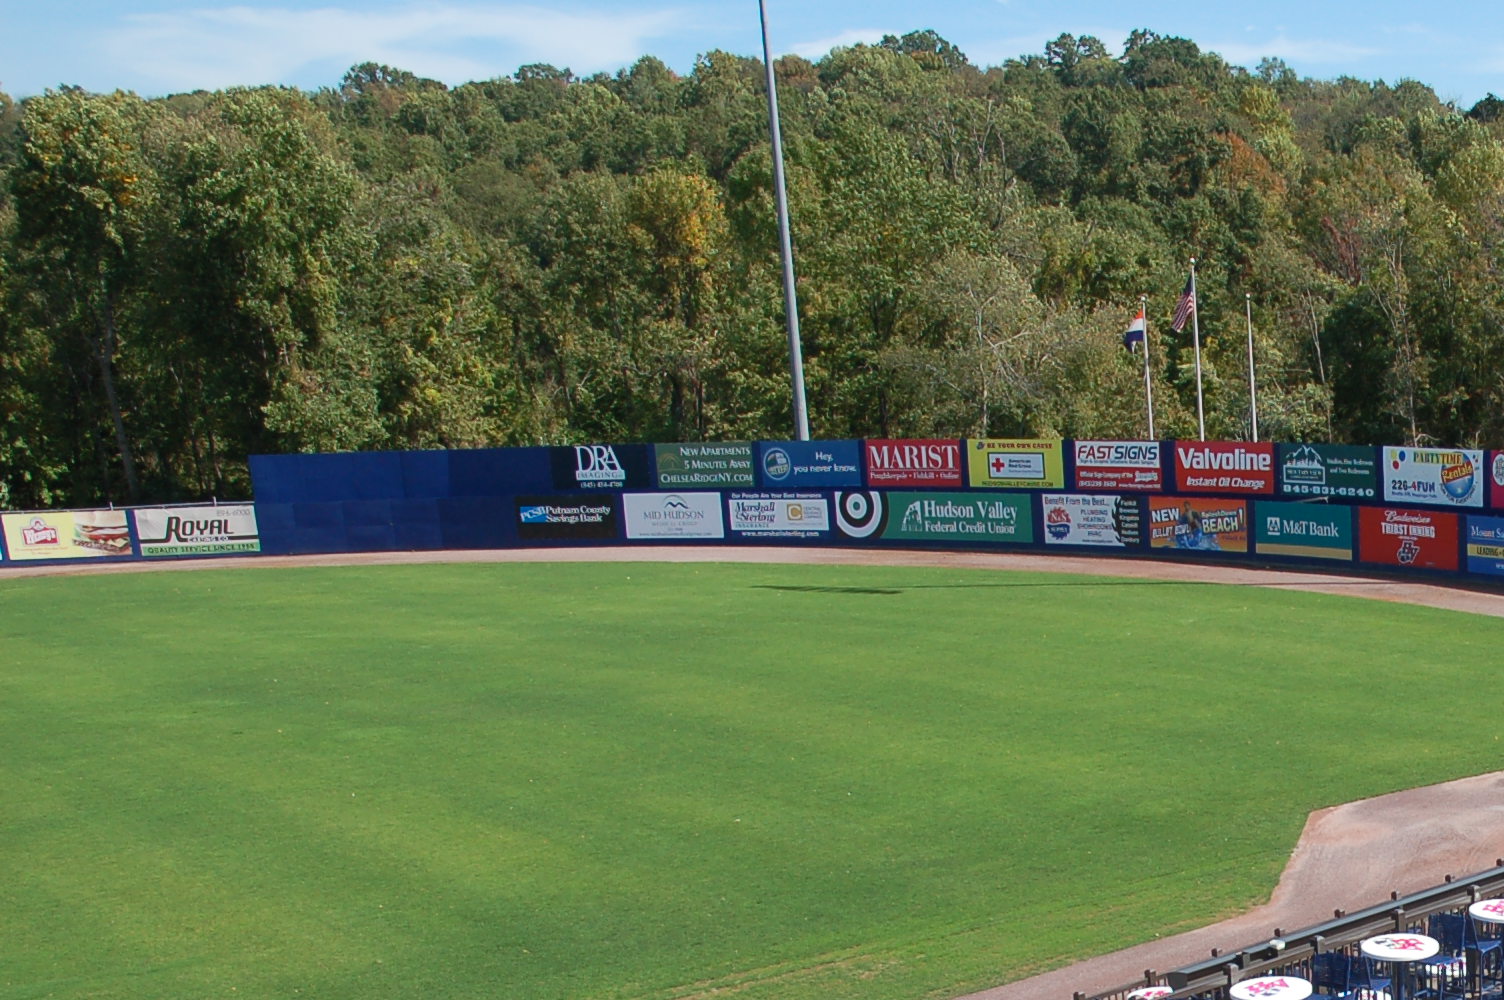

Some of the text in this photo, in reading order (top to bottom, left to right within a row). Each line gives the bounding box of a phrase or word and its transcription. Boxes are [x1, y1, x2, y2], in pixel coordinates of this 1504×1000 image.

[680, 446, 751, 456] NEW APARTMENTS
[869, 445, 959, 468] MARIST
[1077, 445, 1158, 460] FASTSIGNS
[574, 445, 622, 472] DRA
[684, 460, 751, 469] 5 MINUTES AWAY
[1178, 447, 1271, 471] Valvoline
[793, 464, 810, 475] you
[810, 465, 833, 473] never
[1186, 476, 1217, 487] Instant
[1218, 477, 1231, 487] Oil
[735, 502, 776, 512] Marshall
[1044, 497, 1090, 505] Benefit From the
[545, 505, 611, 516] Putnam County
[643, 510, 705, 520] MID HUDSON
[924, 499, 1018, 525] Hudson Valley
[1151, 508, 1179, 523] NEW
[545, 513, 603, 524] Savings Bank
[163, 516, 235, 543] ROYAL
[925, 520, 1015, 535] Federal Credit Union
[1202, 516, 1239, 534] BEACH
[1283, 523, 1339, 538] M&T Bank
[1470, 525, 1495, 537] Mount
[181, 545, 212, 553] SERVICE
[213, 544, 238, 552] SINCE
